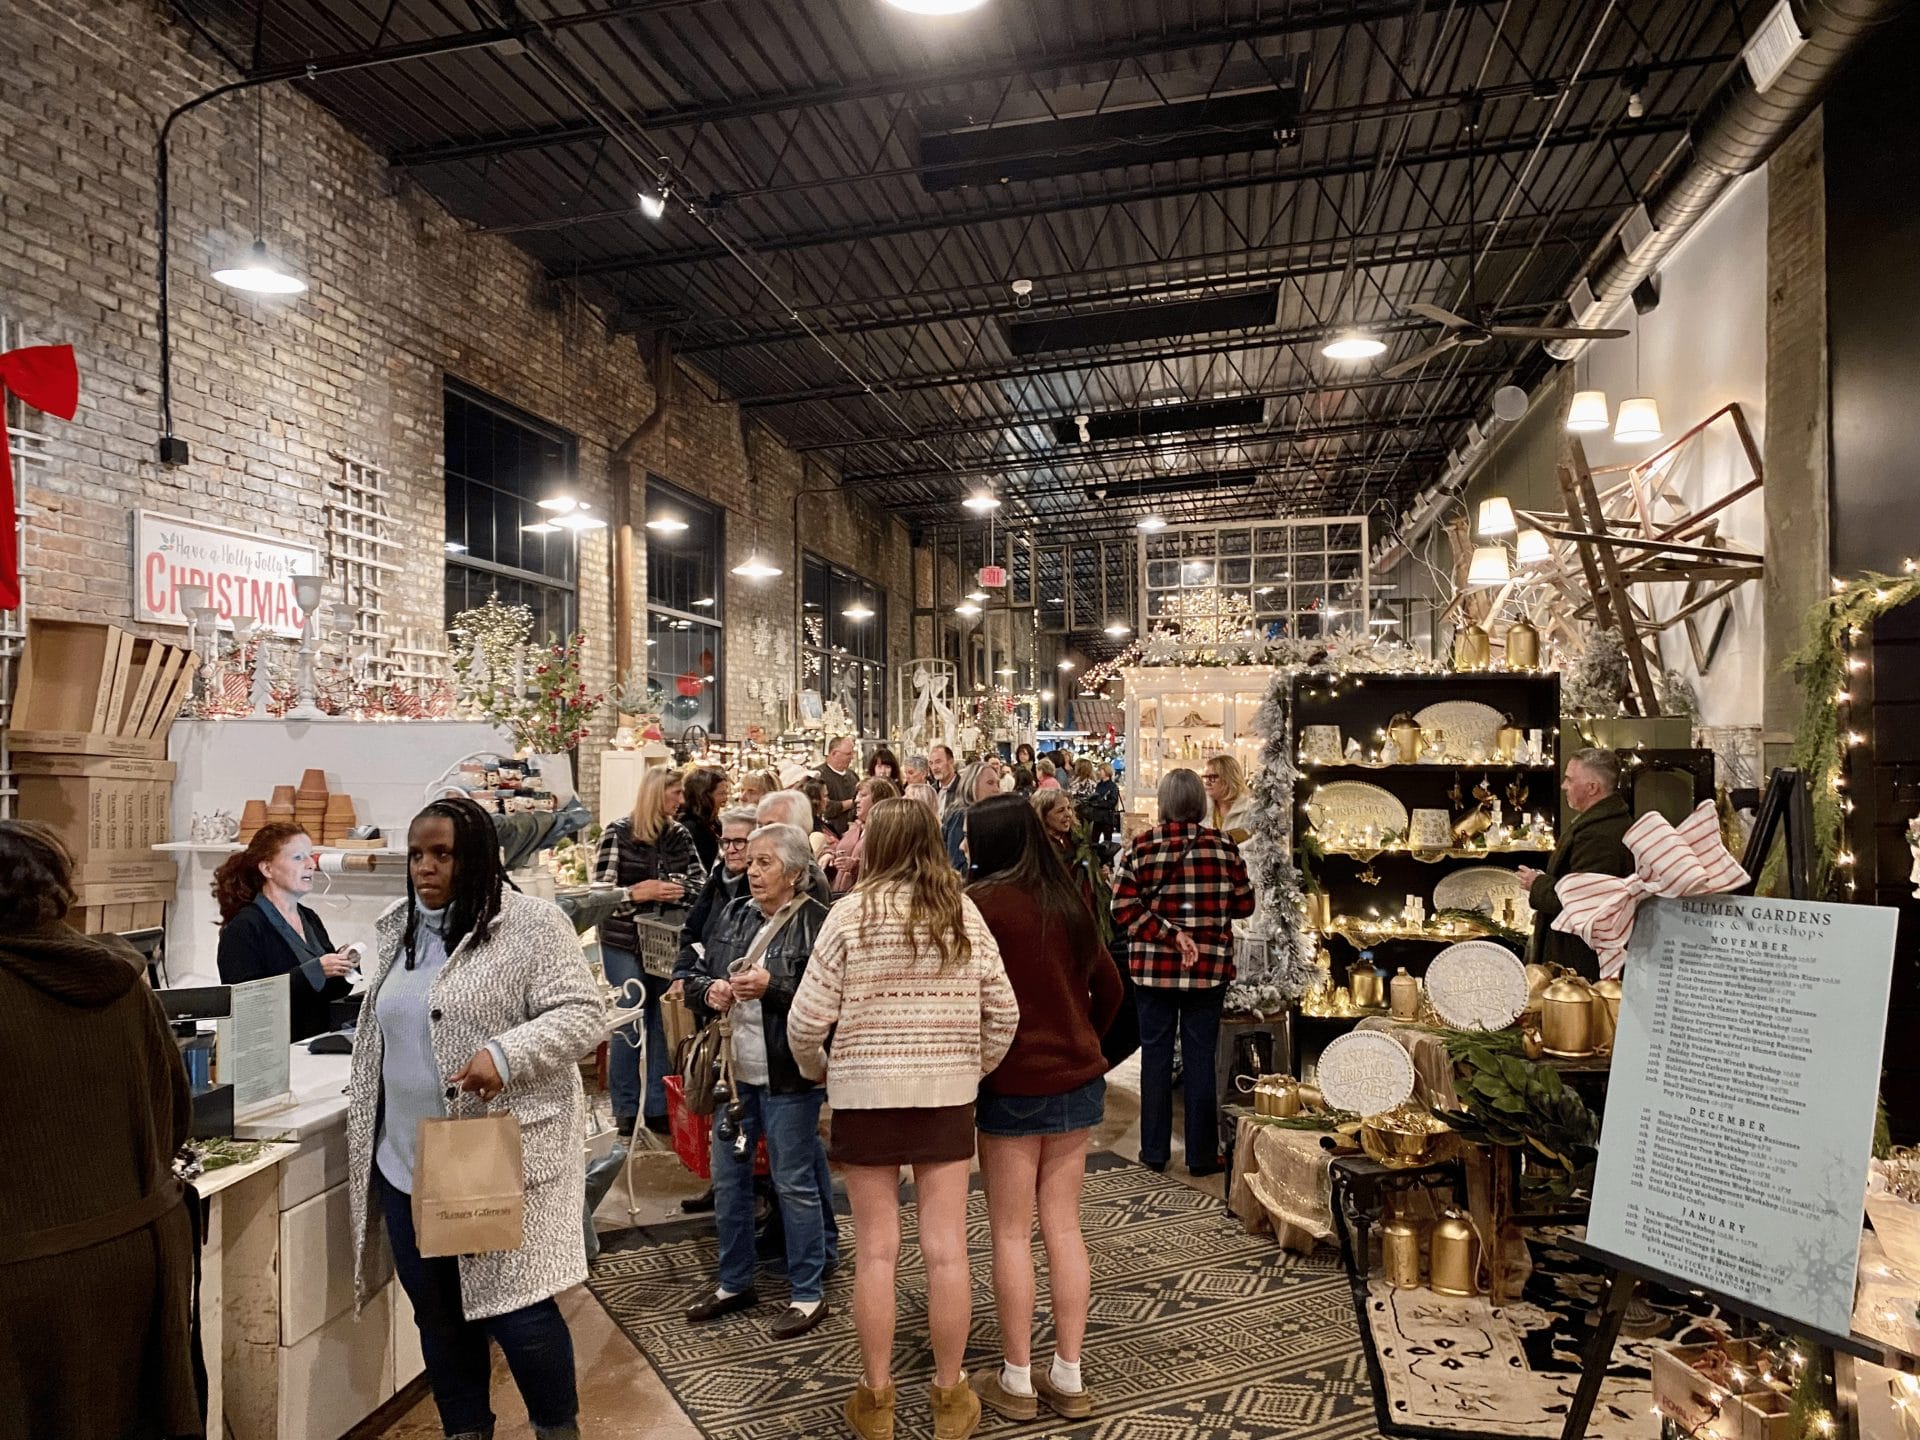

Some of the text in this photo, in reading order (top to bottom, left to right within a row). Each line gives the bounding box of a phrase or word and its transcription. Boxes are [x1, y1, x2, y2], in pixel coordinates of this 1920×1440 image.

[176, 535, 284, 579] Have a Holly Jolly
[1681, 900, 1832, 926] BLUMEN GARDENS
[1683, 914, 1825, 941] Events & Workshops
[1709, 935, 1788, 952] NOVEMBER
[1689, 1106, 1766, 1132] DECEMBER
[1681, 1206, 1746, 1234] JANUARY
